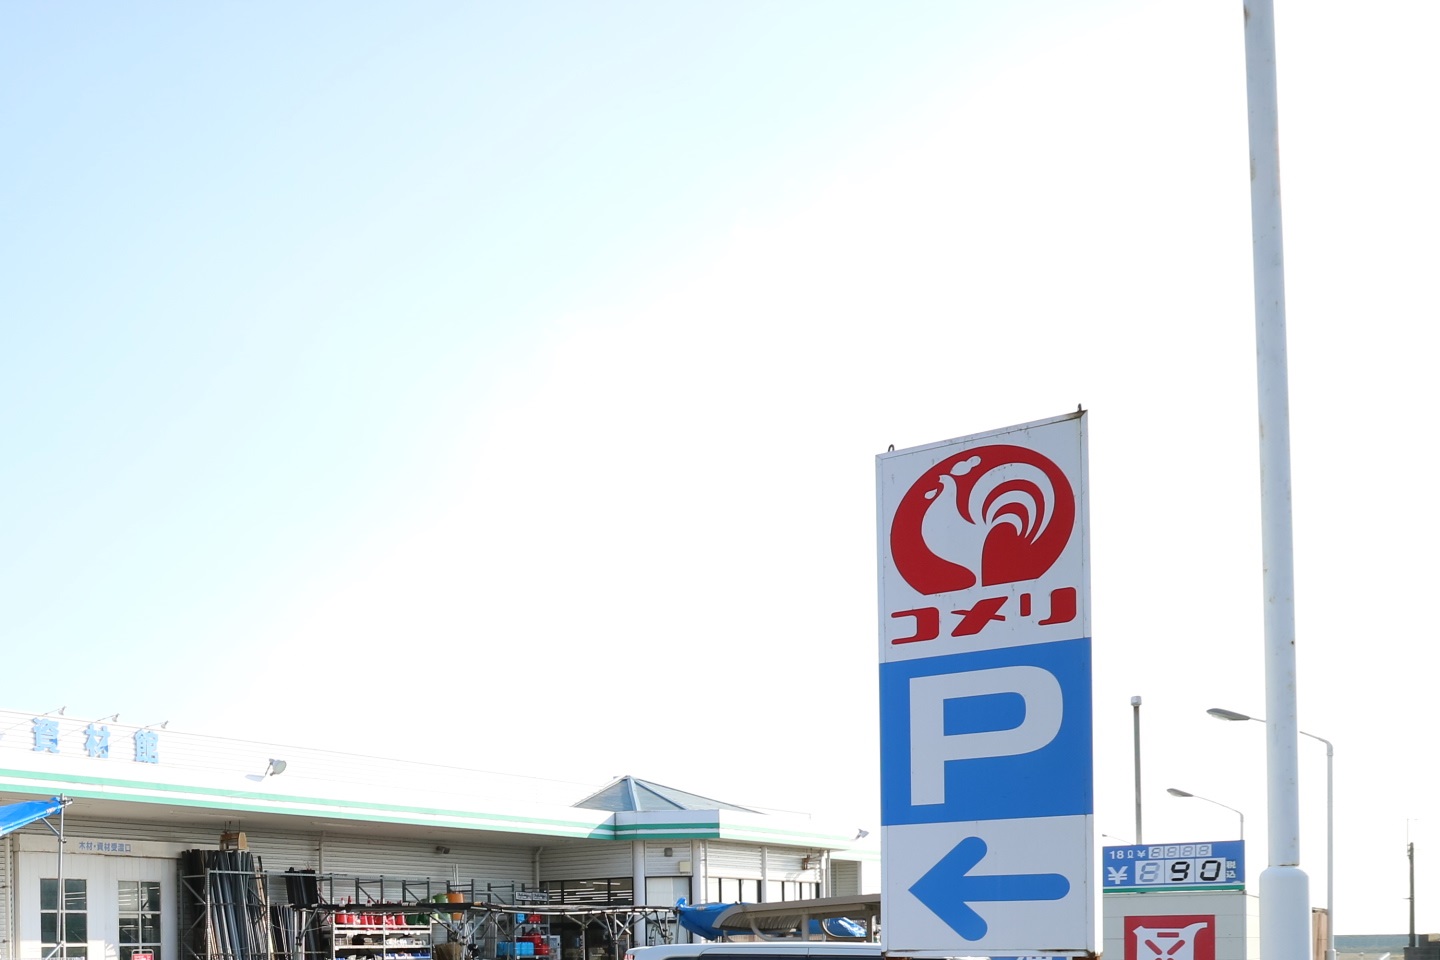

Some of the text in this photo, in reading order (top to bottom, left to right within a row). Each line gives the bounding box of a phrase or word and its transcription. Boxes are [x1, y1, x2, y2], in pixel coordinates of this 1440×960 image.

[891, 586, 1077, 645] コメリ
[31, 717, 159, 764] 資材館
[909, 665, 1064, 806] P
